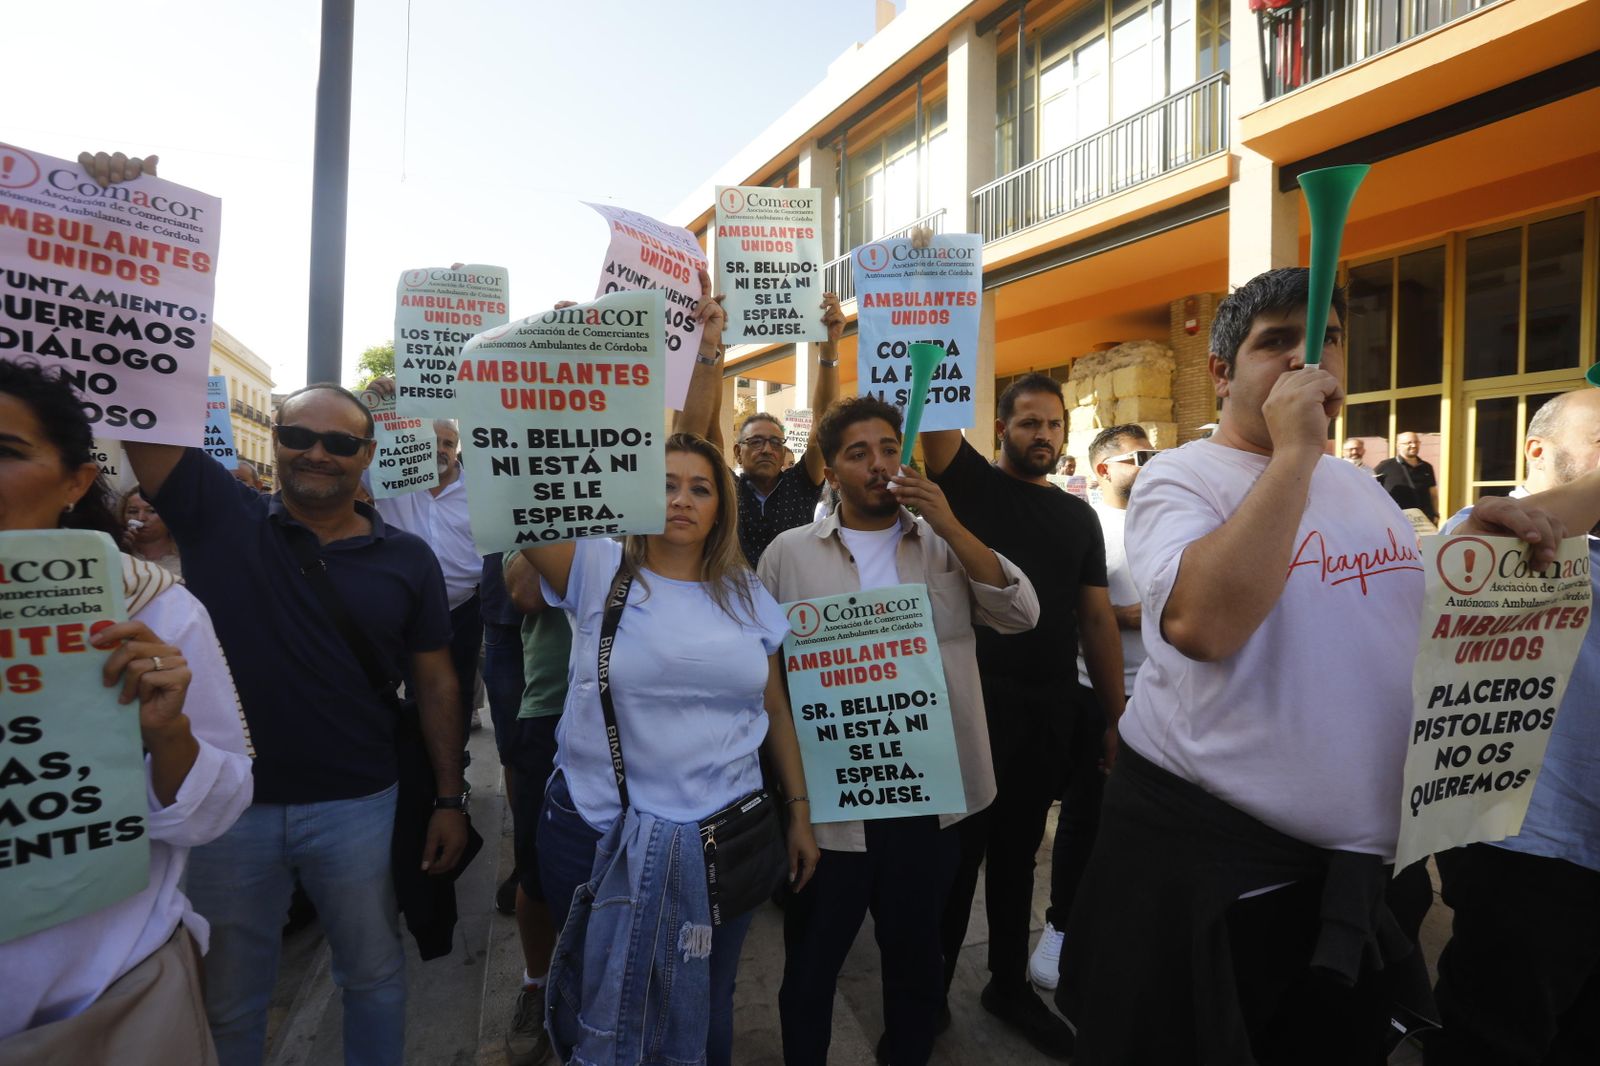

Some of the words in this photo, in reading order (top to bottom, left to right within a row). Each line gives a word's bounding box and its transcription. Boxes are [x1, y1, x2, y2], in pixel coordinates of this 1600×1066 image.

[48, 169, 203, 221] Comacor
[747, 193, 814, 209] Comacor
[41, 189, 106, 207] Asociación
[109, 201, 125, 212] de
[128, 206, 203, 233] Comerciantes
[59, 204, 131, 227] Ambulantes
[135, 221, 149, 232] de
[153, 225, 200, 245] Córdoba
[718, 225, 815, 239] AMBULANTES
[0, 204, 211, 273] MBULANTES
[741, 239, 794, 253] UNIDOS
[27, 238, 161, 287] UNIDOS
[892, 244, 975, 261] Comacor
[640, 245, 691, 284] UNIDOS
[726, 261, 750, 274] SR.
[754, 261, 818, 274] BELLIDO:
[892, 262, 926, 270] Asociación
[430, 269, 502, 287] Comacor
[605, 260, 699, 312] AYUNTAIENTO
[735, 277, 749, 290] NI
[754, 273, 791, 290] ESTÁ
[796, 277, 810, 289] NI
[0, 267, 206, 324] UNTAMIENTO:
[401, 295, 506, 315] AMBULANTES
[755, 293, 772, 305] SE
[776, 293, 792, 304] LE
[863, 291, 977, 308] AMBULANTES
[0, 293, 196, 349] UEREMOS
[424, 310, 483, 326] UNIDOS
[743, 307, 804, 321] ESPERA.
[892, 309, 950, 325] UNIDOS
[401, 328, 430, 341] LOS
[515, 326, 565, 337] Asociación
[568, 328, 580, 336] de
[582, 329, 650, 340] Comerciantes
[743, 319, 806, 337] MÓJESE.
[406, 342, 455, 356] ESTÁN
[529, 339, 587, 351] Ambulantes
[589, 341, 602, 351] de
[604, 341, 648, 353] Córdoba
[877, 338, 960, 359] COA
[60, 366, 118, 395] NO
[420, 373, 442, 384] NO
[457, 359, 650, 386] AMBULANTES
[871, 365, 899, 384] LA
[905, 362, 963, 383] BIA
[501, 388, 606, 412] UNIDOS
[895, 385, 971, 407] STOR
[80, 401, 158, 430] OSO
[384, 418, 422, 432] UNIDOS
[395, 434, 416, 444] LOS
[472, 427, 518, 449] SR.
[527, 427, 652, 449] BELLIDO:
[380, 441, 432, 457] PLACEROS
[379, 458, 396, 468] NO
[399, 452, 432, 467] PUEDEN
[491, 455, 520, 476] NI
[528, 448, 602, 476] ESTÁ
[610, 454, 637, 473] NI
[382, 472, 434, 490] VERDUGOS
[402, 466, 419, 477] SER
[533, 482, 566, 501] SE
[573, 480, 602, 499] LE
[512, 503, 624, 525] ESPERA.
[515, 523, 627, 544] MÓJESE.
[0, 585, 104, 600] merciantes
[1490, 582, 1539, 592] Asociación
[1540, 583, 1554, 592] de
[20, 602, 103, 618] Córdoba
[823, 597, 919, 622] Comacor
[1445, 596, 1499, 608] Autónomos
[824, 620, 862, 632] Asociación
[864, 618, 873, 626] de
[874, 611, 923, 624] Comerciantes
[1431, 606, 1589, 639] AMBULANTES
[795, 634, 836, 647] Autónomos
[837, 628, 879, 641] Ambulantes
[880, 626, 890, 634] de
[891, 621, 923, 632] Córdoba
[787, 636, 928, 672] AMBULANTES
[1454, 636, 1544, 664] UNIDOS
[599, 637, 613, 693] BIMBA
[820, 662, 897, 688] UNIDOS
[1427, 676, 1556, 709] PLACEROS
[801, 703, 835, 721] SR.
[841, 690, 937, 717] BELLIDO:
[816, 724, 838, 742] NI
[843, 711, 900, 739] ESTÁ
[905, 713, 928, 732] NI
[1413, 707, 1556, 745] PISTOLEROS
[606, 725, 625, 785] BIMBA
[848, 743, 874, 761] SE
[879, 740, 903, 758] LE
[1434, 745, 1472, 770] NO
[1477, 741, 1514, 765] OS
[835, 762, 924, 785] ESPERA.
[838, 783, 930, 808] MÓJESE.
[1410, 769, 1531, 817] QUEREMOS
